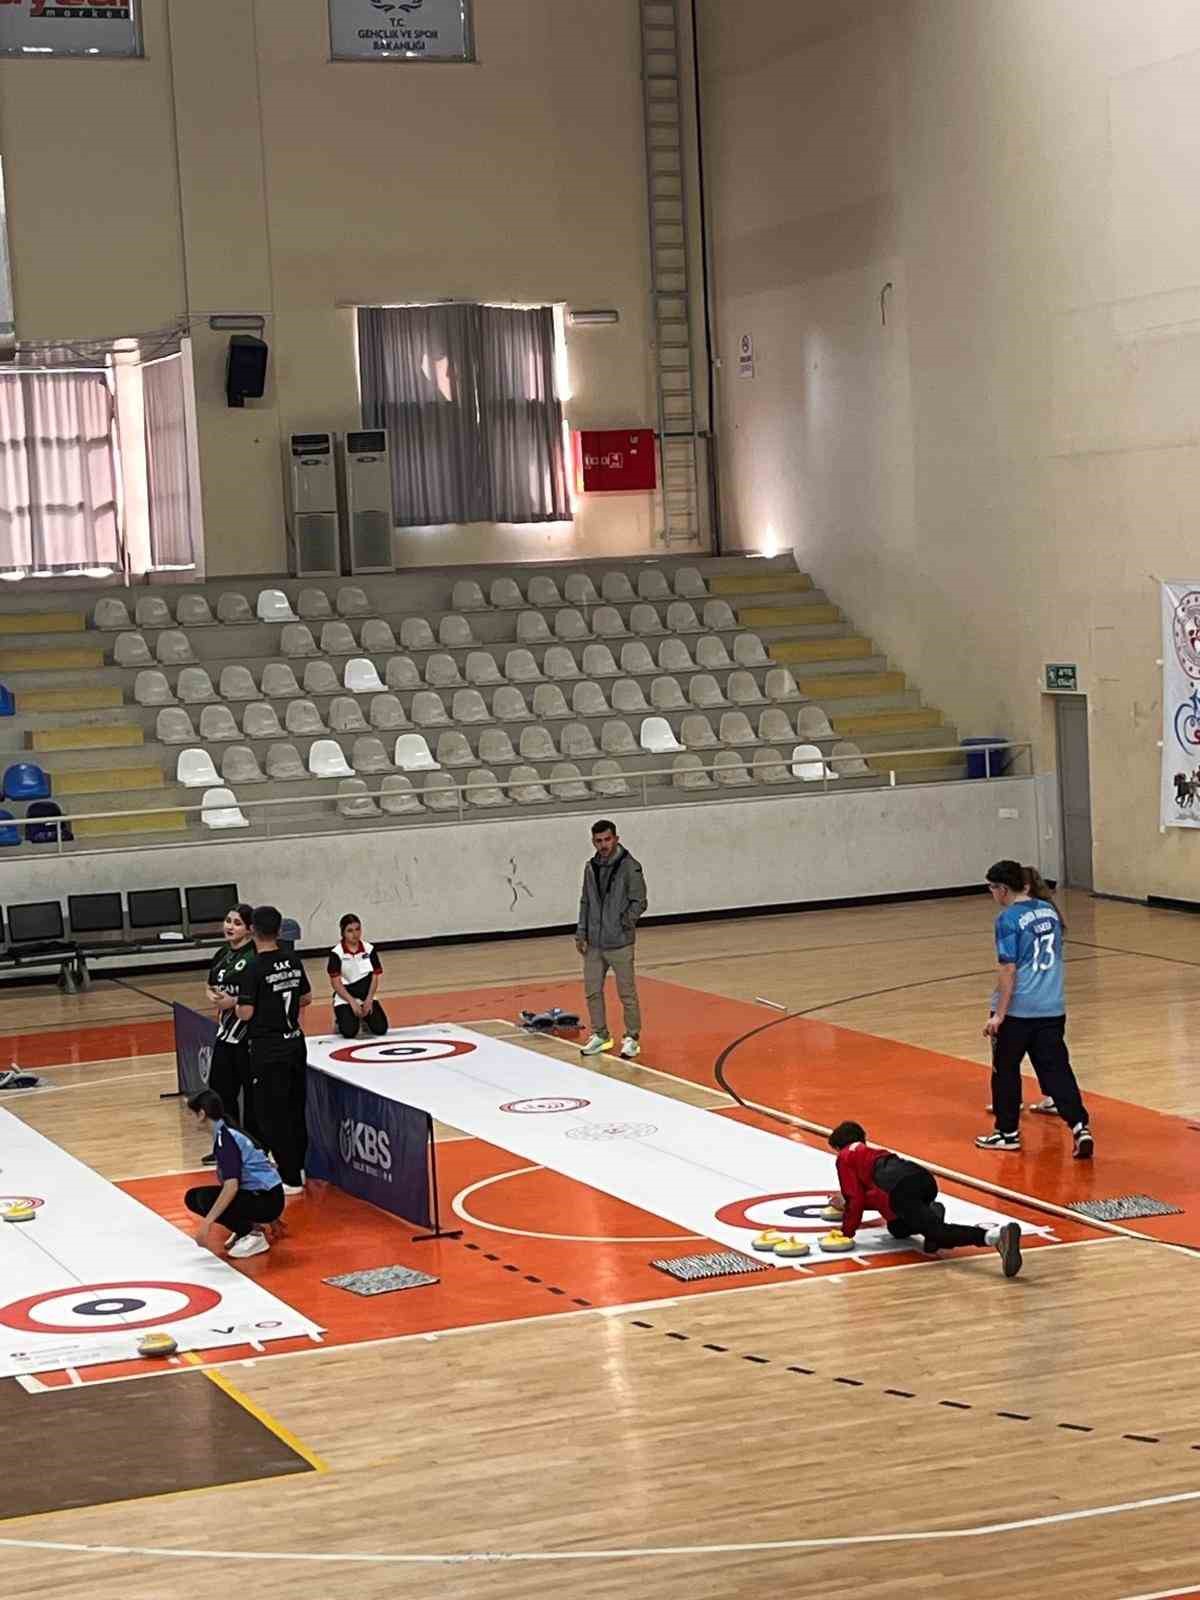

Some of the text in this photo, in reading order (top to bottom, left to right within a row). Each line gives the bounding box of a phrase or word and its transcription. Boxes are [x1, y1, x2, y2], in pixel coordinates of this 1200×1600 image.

[1032, 933, 1056, 972] 13
[216, 968, 227, 982] 5
[281, 990, 293, 1030] 7
[351, 1121, 392, 1170] KBS
